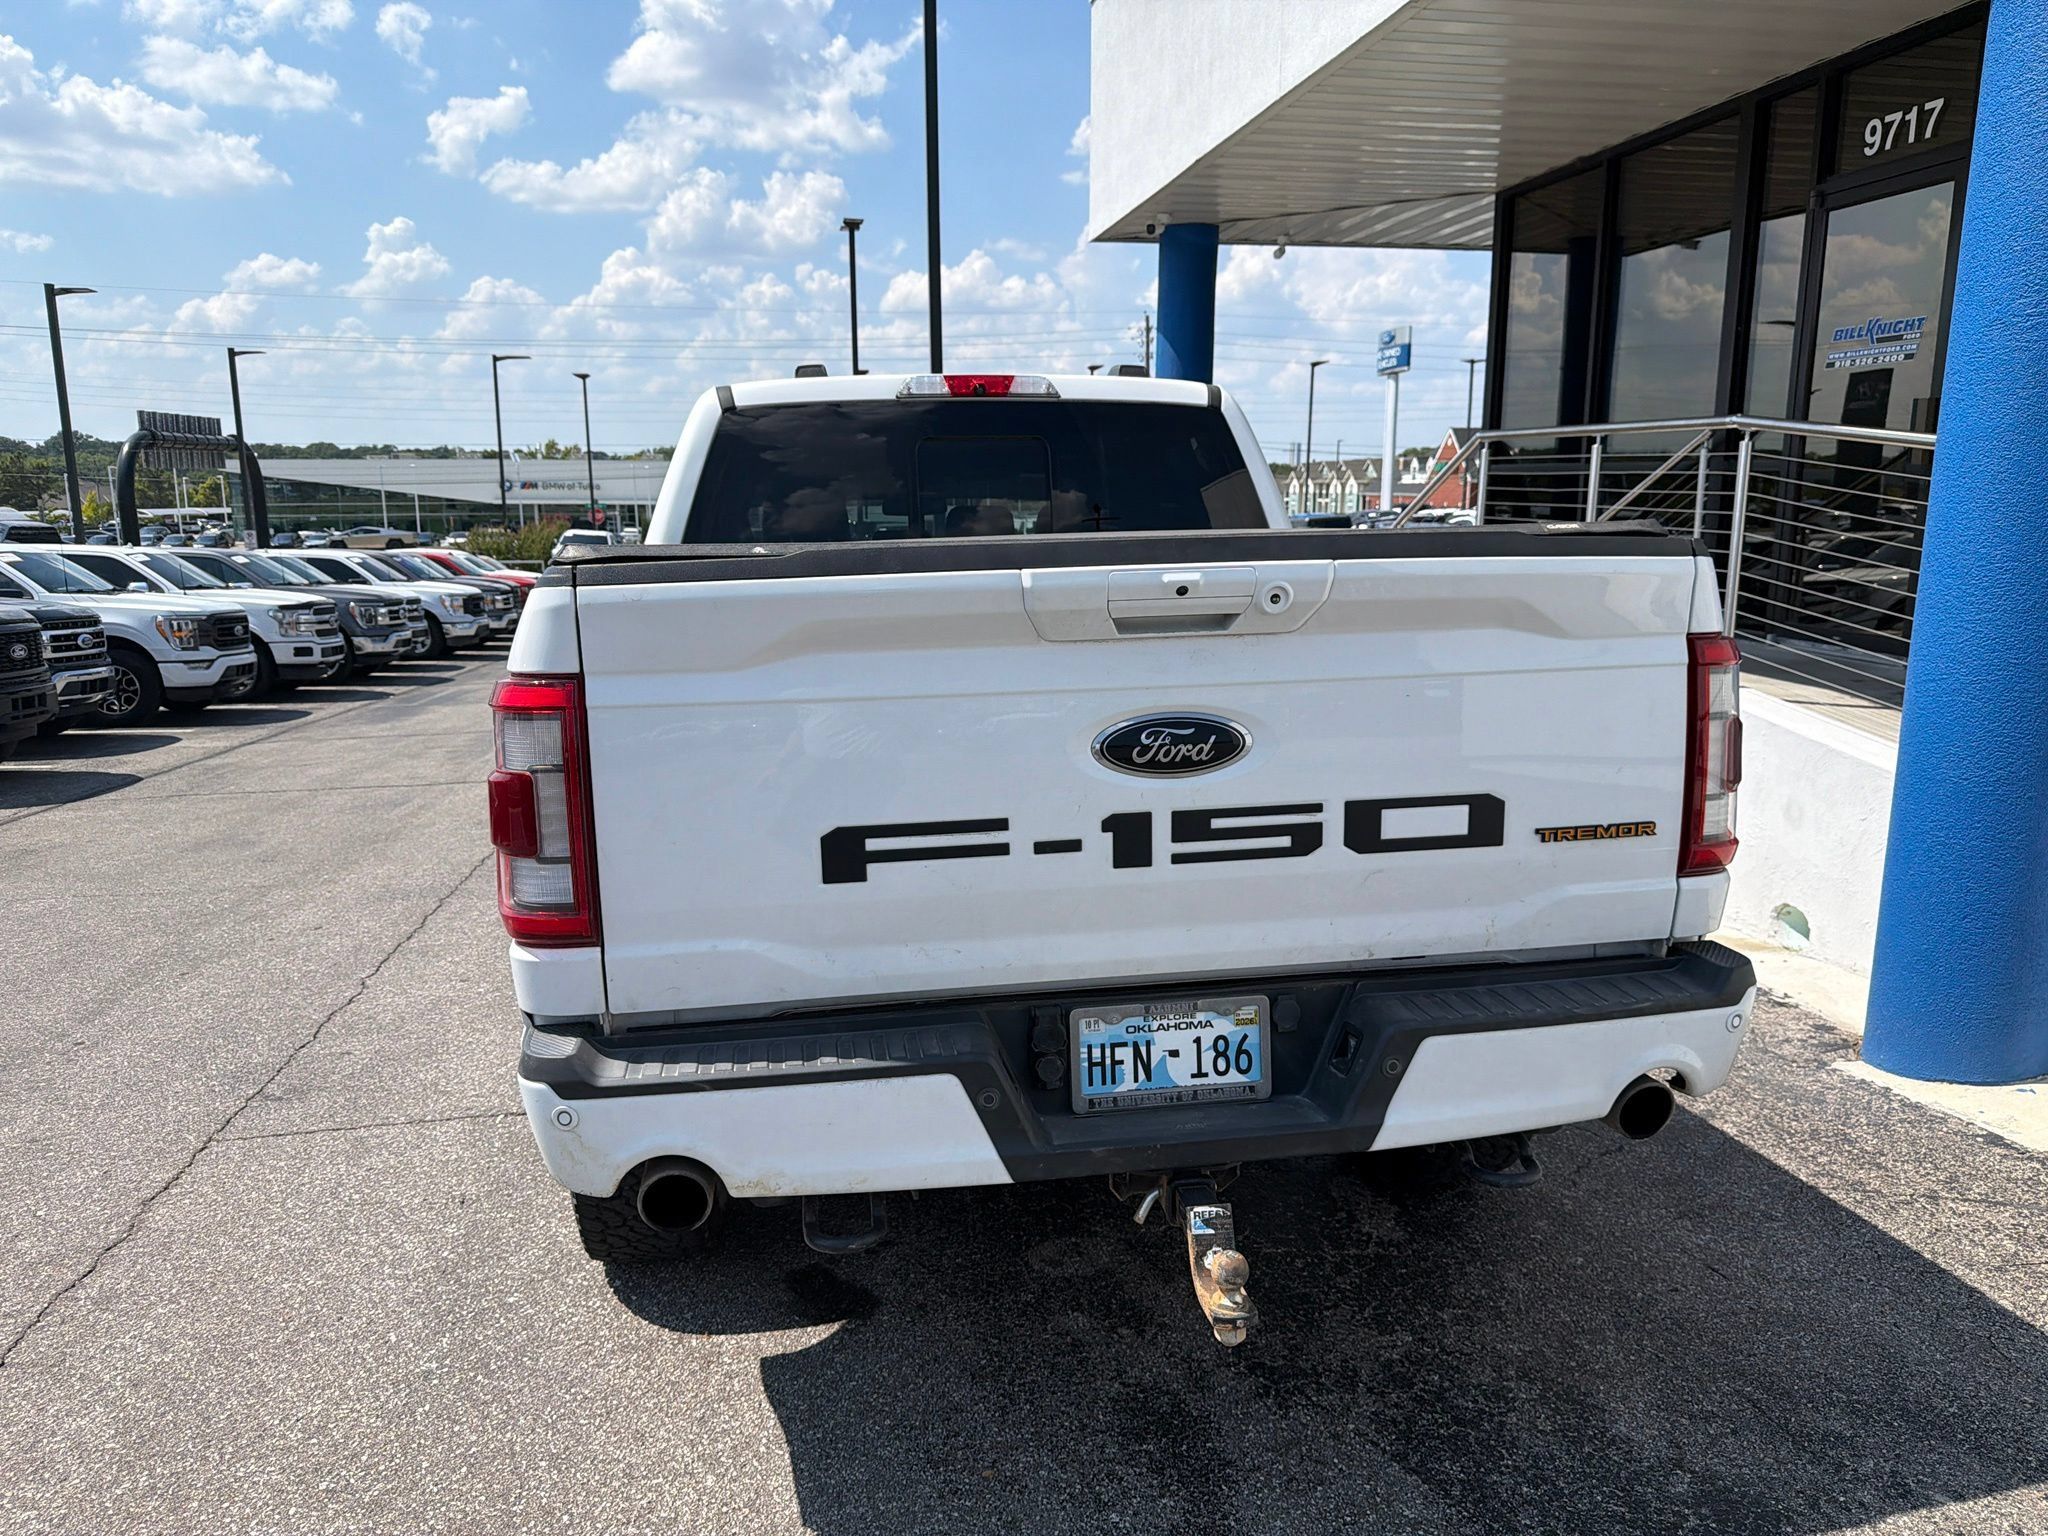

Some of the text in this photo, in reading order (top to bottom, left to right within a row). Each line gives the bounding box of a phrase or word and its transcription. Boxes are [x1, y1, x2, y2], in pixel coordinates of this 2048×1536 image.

[1863, 98, 1944, 156] 9717
[1132, 727, 1216, 764] Ford
[820, 793, 1505, 885] F-150
[1535, 821, 1657, 843] TREMOR
[1125, 1020, 1214, 1034] OKLAHOMA
[1143, 1012, 1197, 1023] EXPLORE
[1235, 1017, 1255, 1026] 2026
[1093, 1098, 1114, 1109] THE
[1117, 1092, 1178, 1107] UNIVERSITY
[1181, 1090, 1194, 1101] OF
